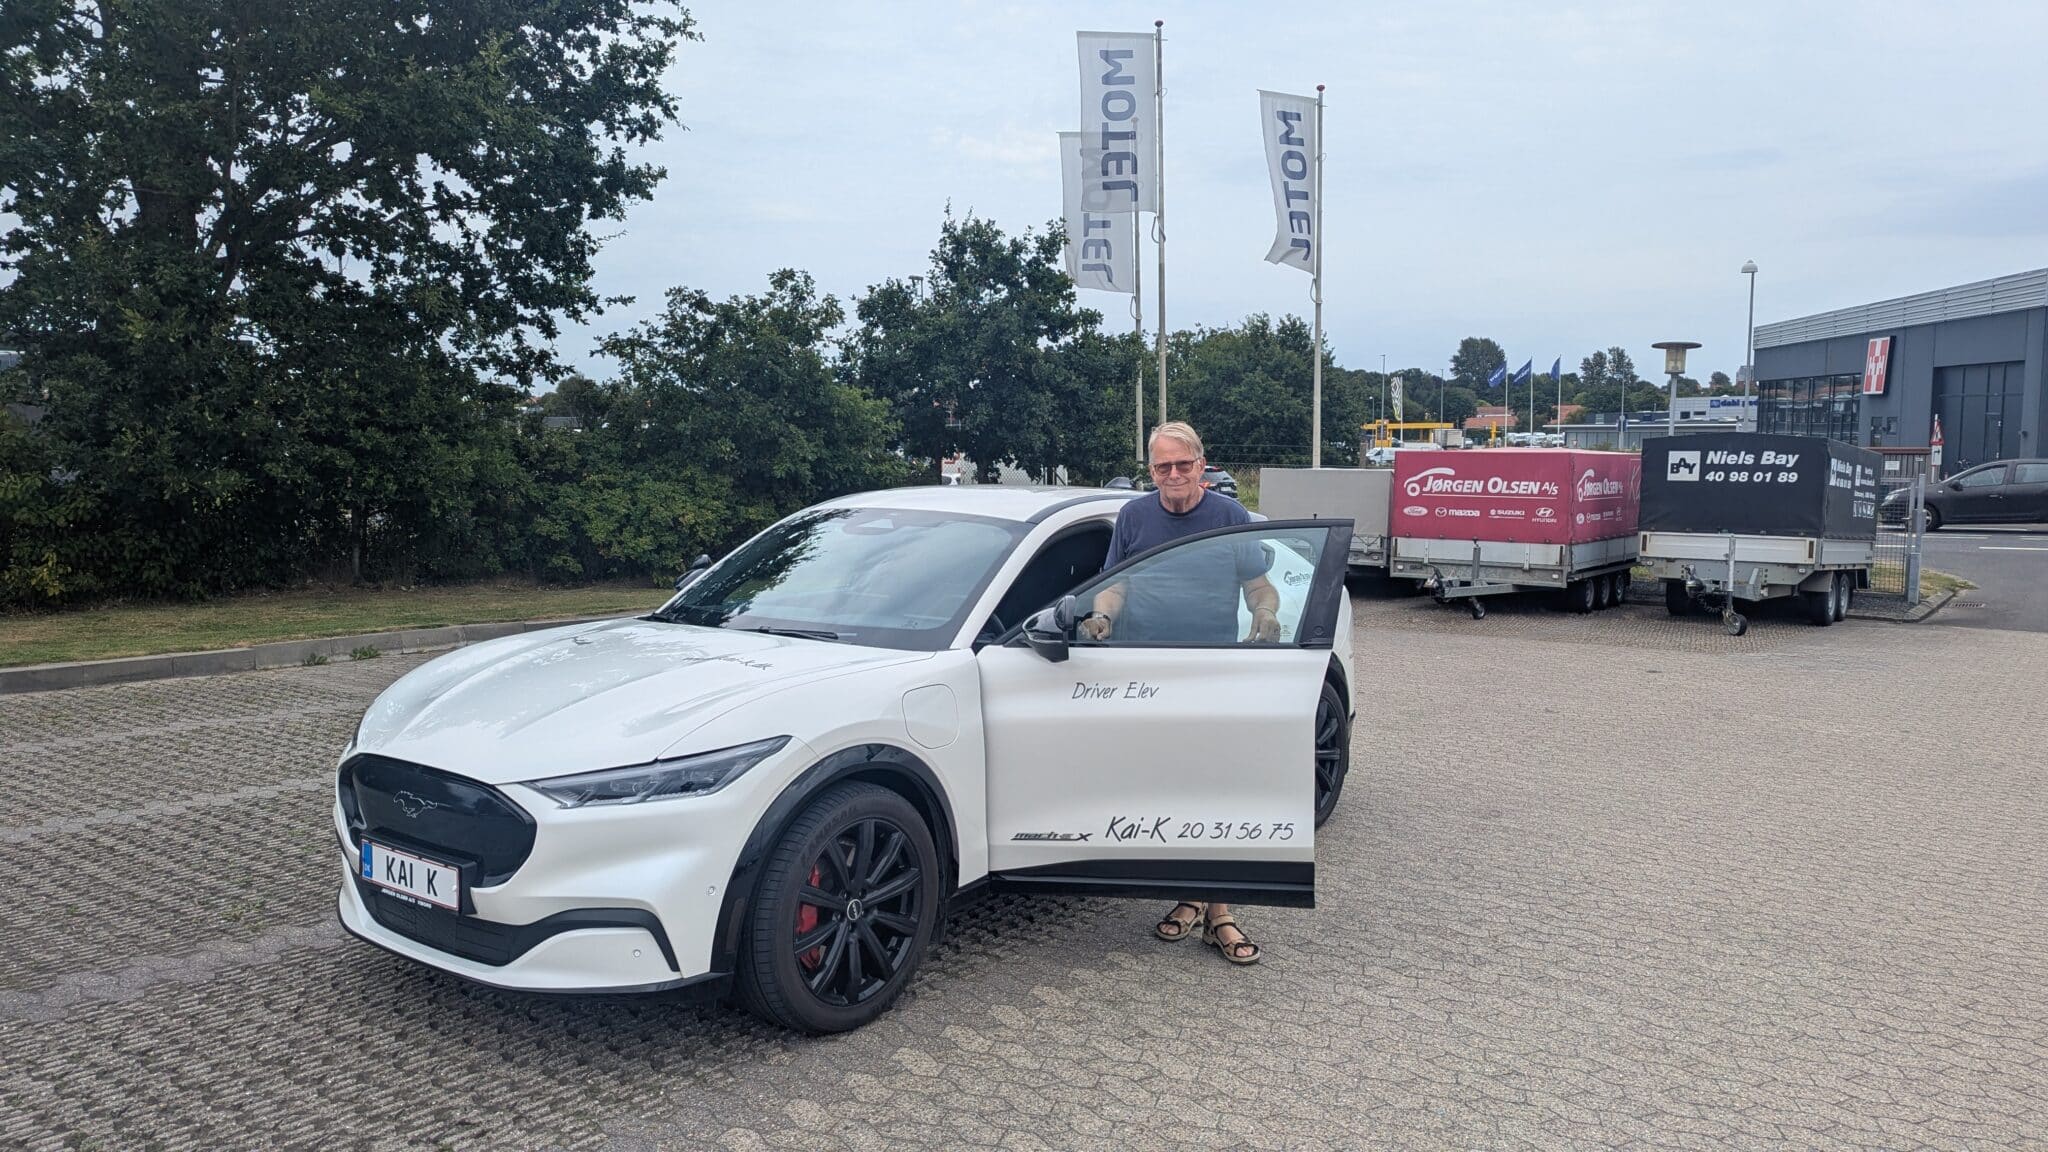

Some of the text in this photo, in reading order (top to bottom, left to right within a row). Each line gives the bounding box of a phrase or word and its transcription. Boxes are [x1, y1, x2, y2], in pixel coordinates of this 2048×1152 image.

[1670, 457, 1696, 474] BAY
[1706, 451, 1799, 467] Niels Bay
[1705, 471, 1798, 482] 40 98 01 89
[1423, 476, 1558, 495] JØRGEN OLSEN A/S
[1072, 682, 1160, 699] Driver Elev
[1105, 816, 1295, 843] Kai-K 20 31 56 75
[386, 855, 438, 897] KAI K
